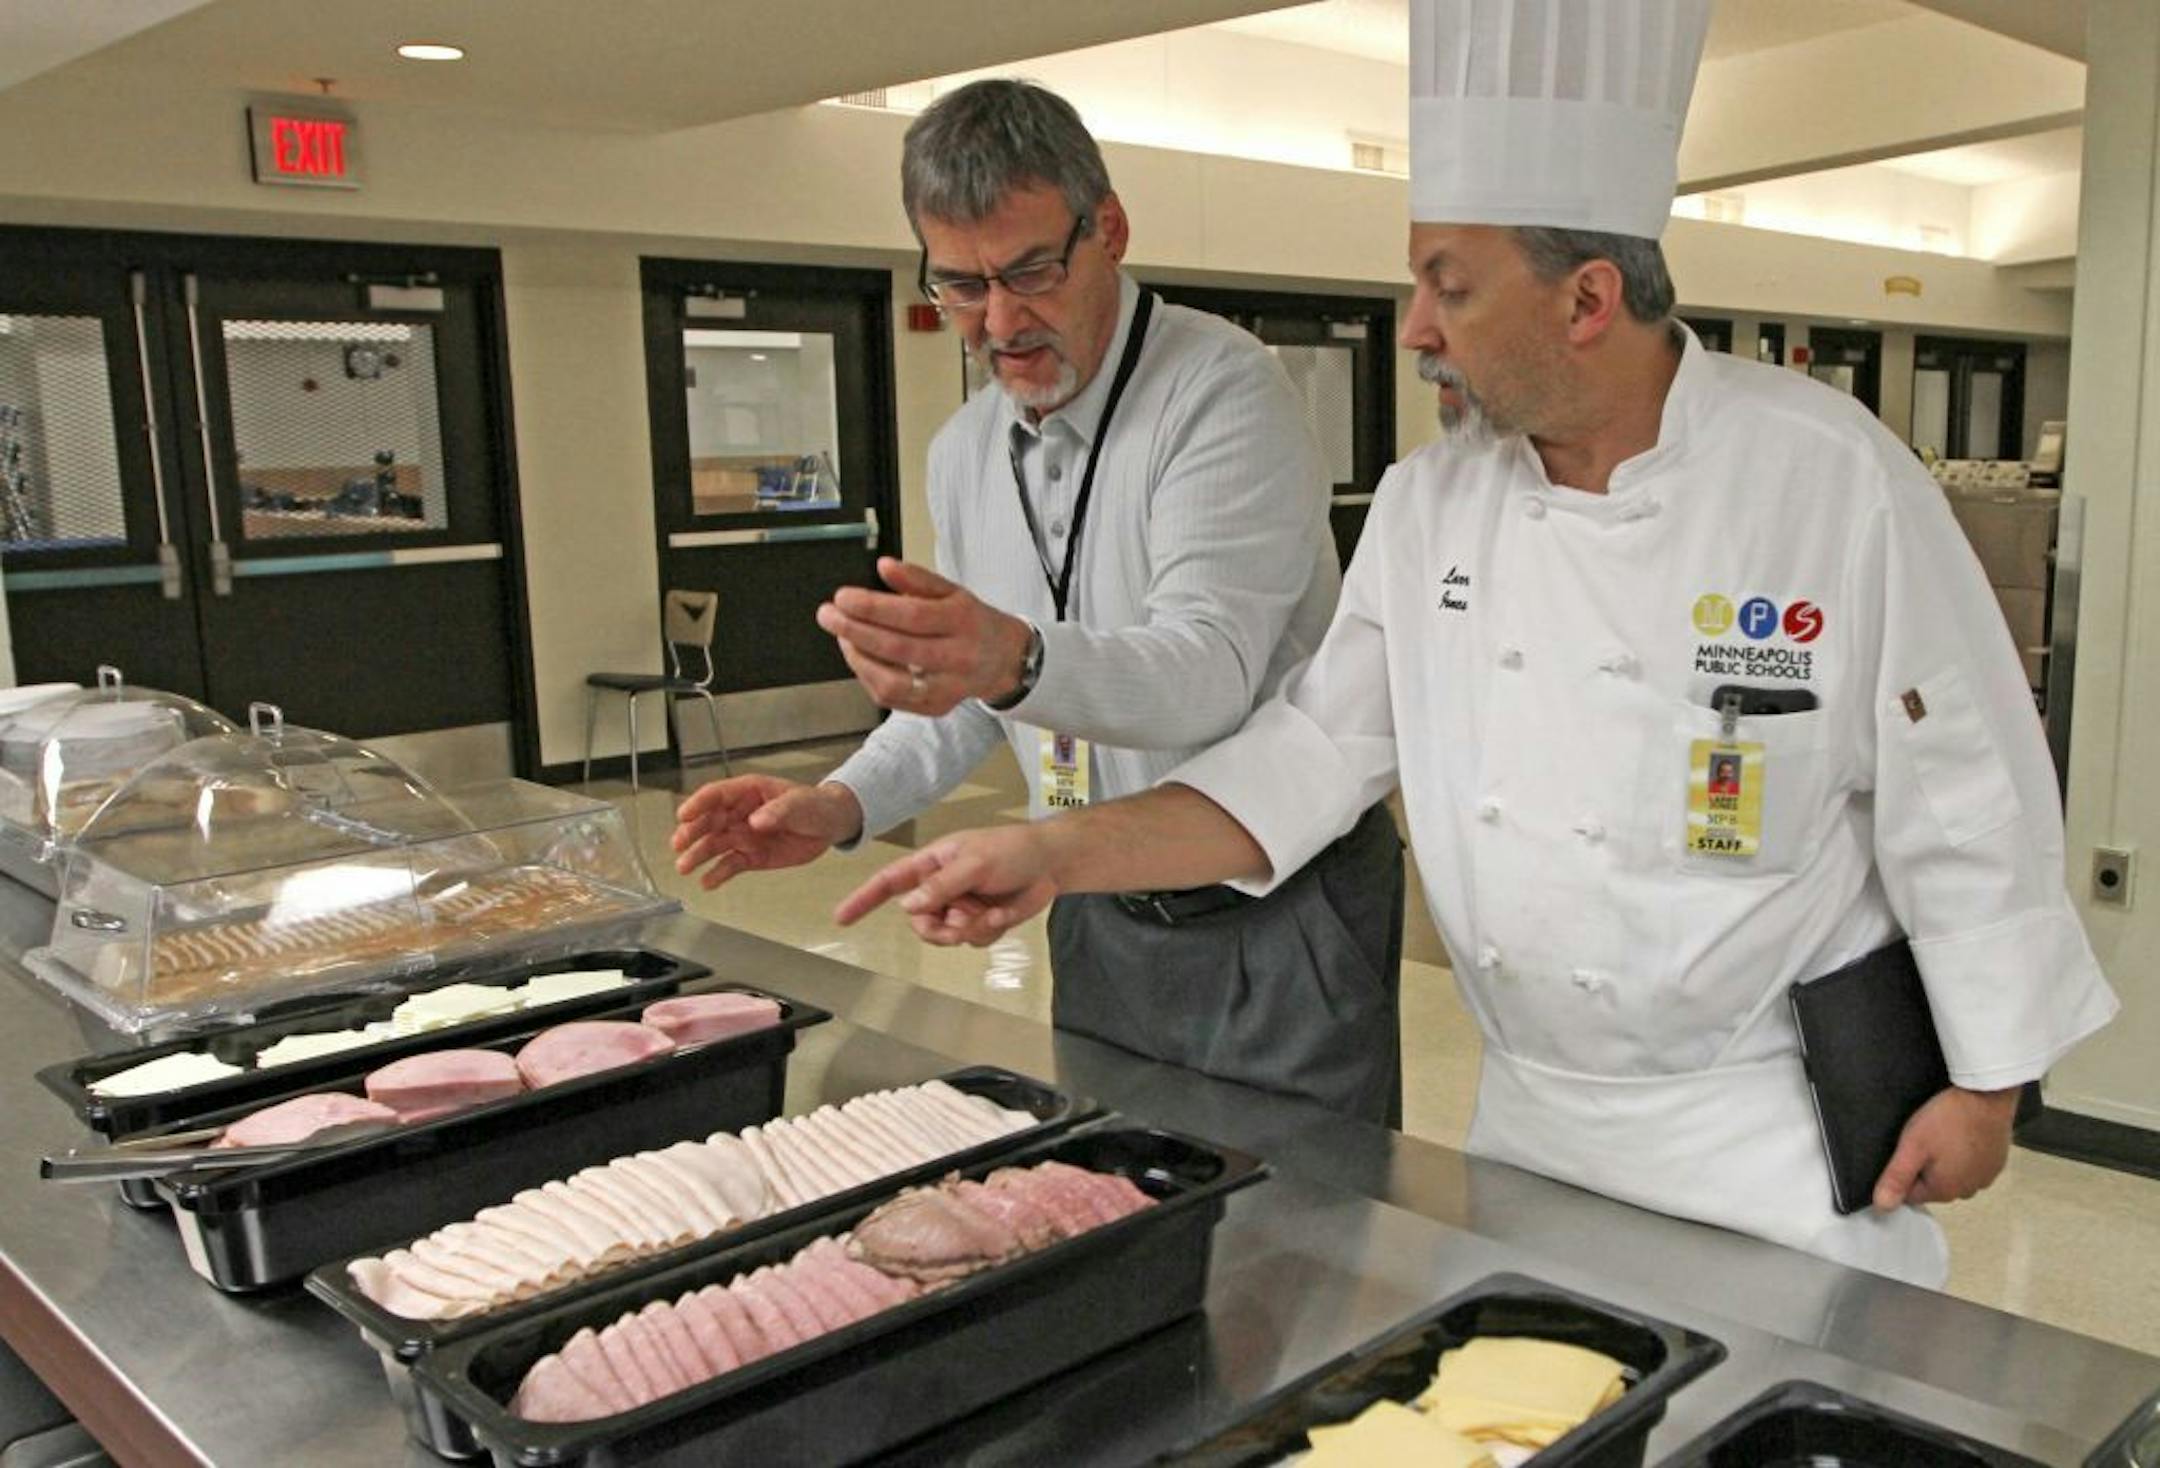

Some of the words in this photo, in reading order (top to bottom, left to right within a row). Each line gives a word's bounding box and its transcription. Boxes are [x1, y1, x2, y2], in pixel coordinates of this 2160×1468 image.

[271, 117, 346, 177] EXIT
[1697, 645, 1812, 666] MINNEAPOLIS
[1695, 658, 1741, 675] PUBLIC
[1745, 662, 1812, 680] SCHOOLS
[1048, 795, 1085, 808] STAFF
[1698, 837, 1742, 851] STAFF
